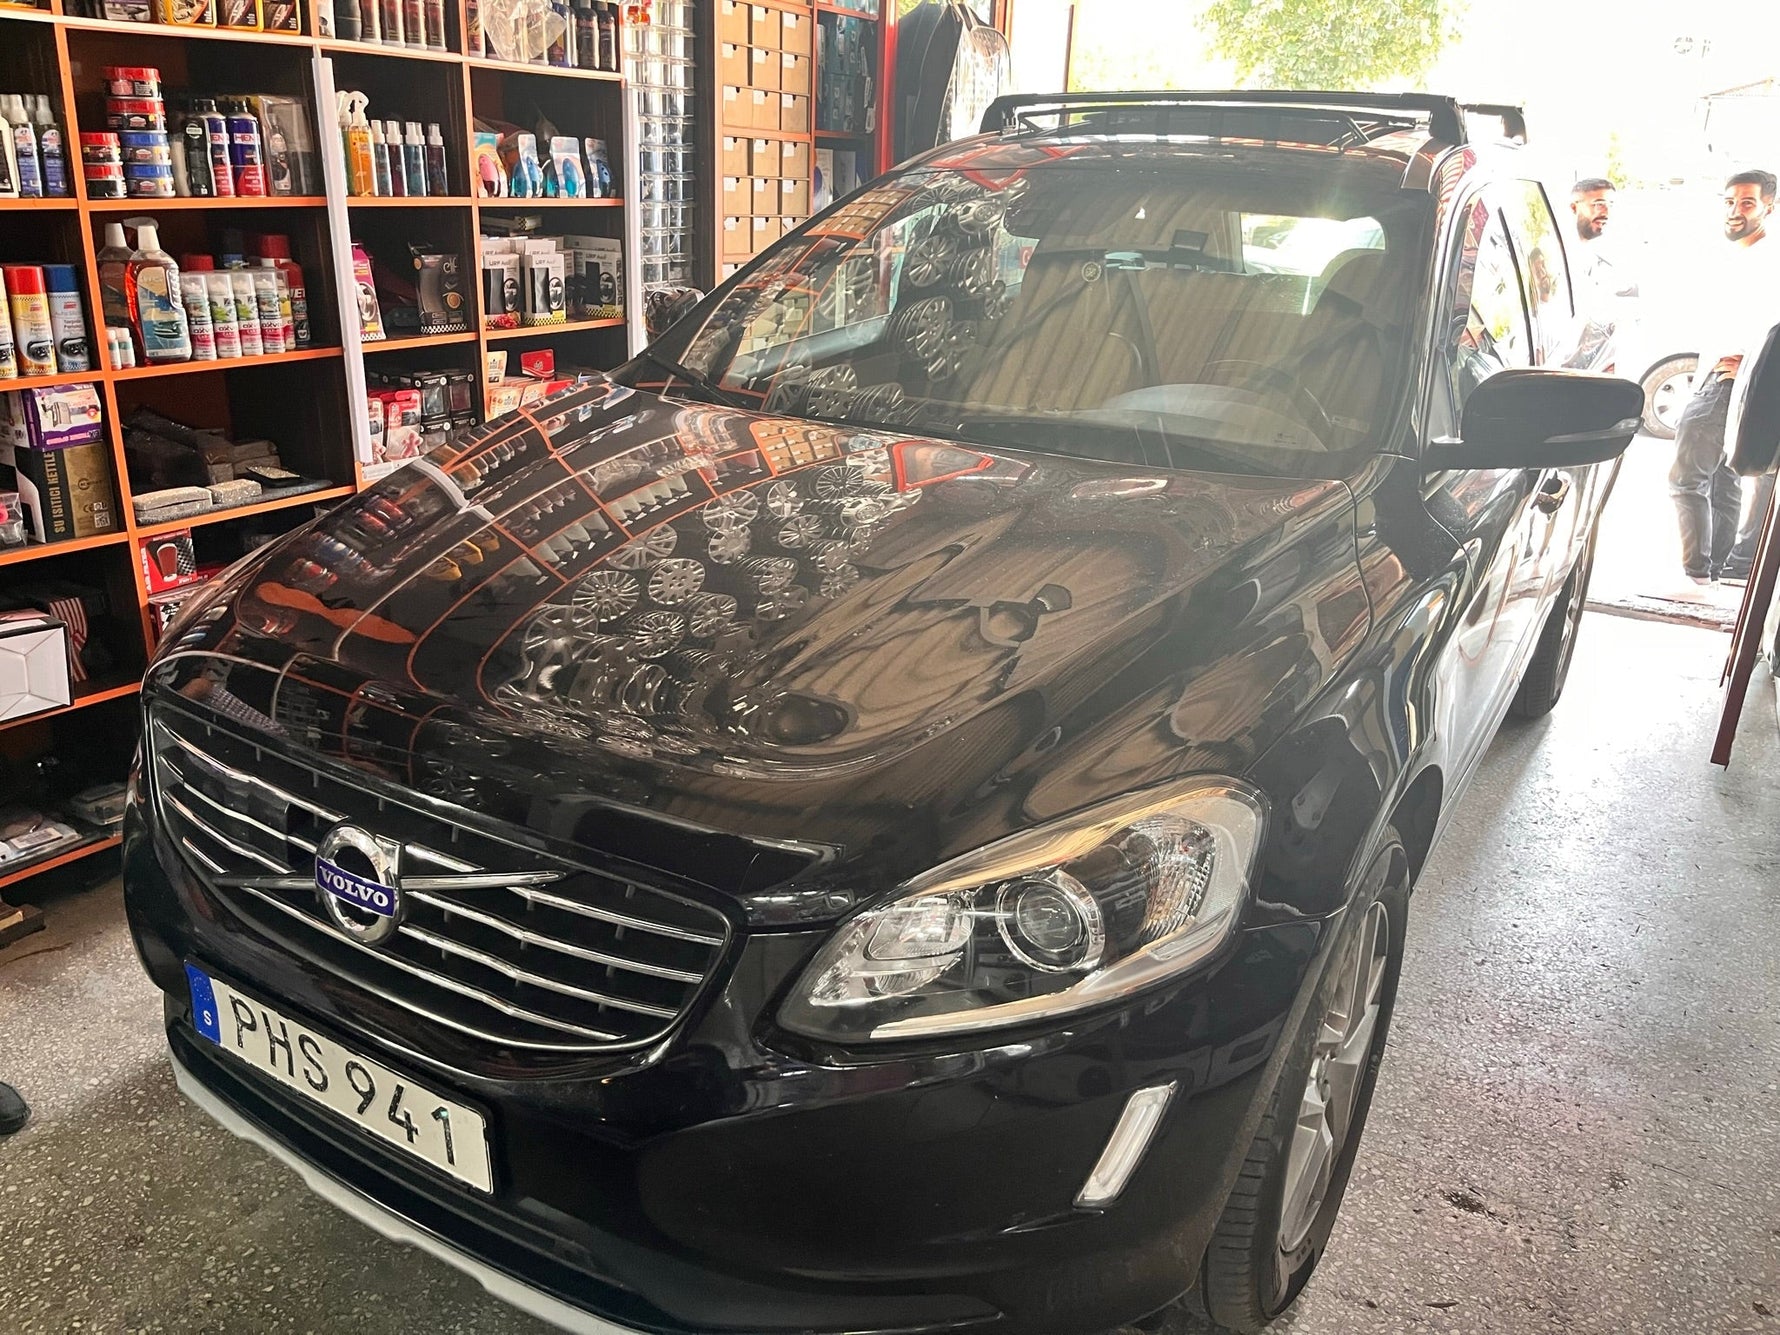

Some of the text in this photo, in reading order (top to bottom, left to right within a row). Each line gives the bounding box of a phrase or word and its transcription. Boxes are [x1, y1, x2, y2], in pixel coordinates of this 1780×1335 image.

[44, 451, 59, 485] KETTLE
[54, 520, 66, 534] SU
[319, 865, 389, 909] VOLVO
[203, 1009, 213, 1026] S
[229, 993, 456, 1166] PHS 941
